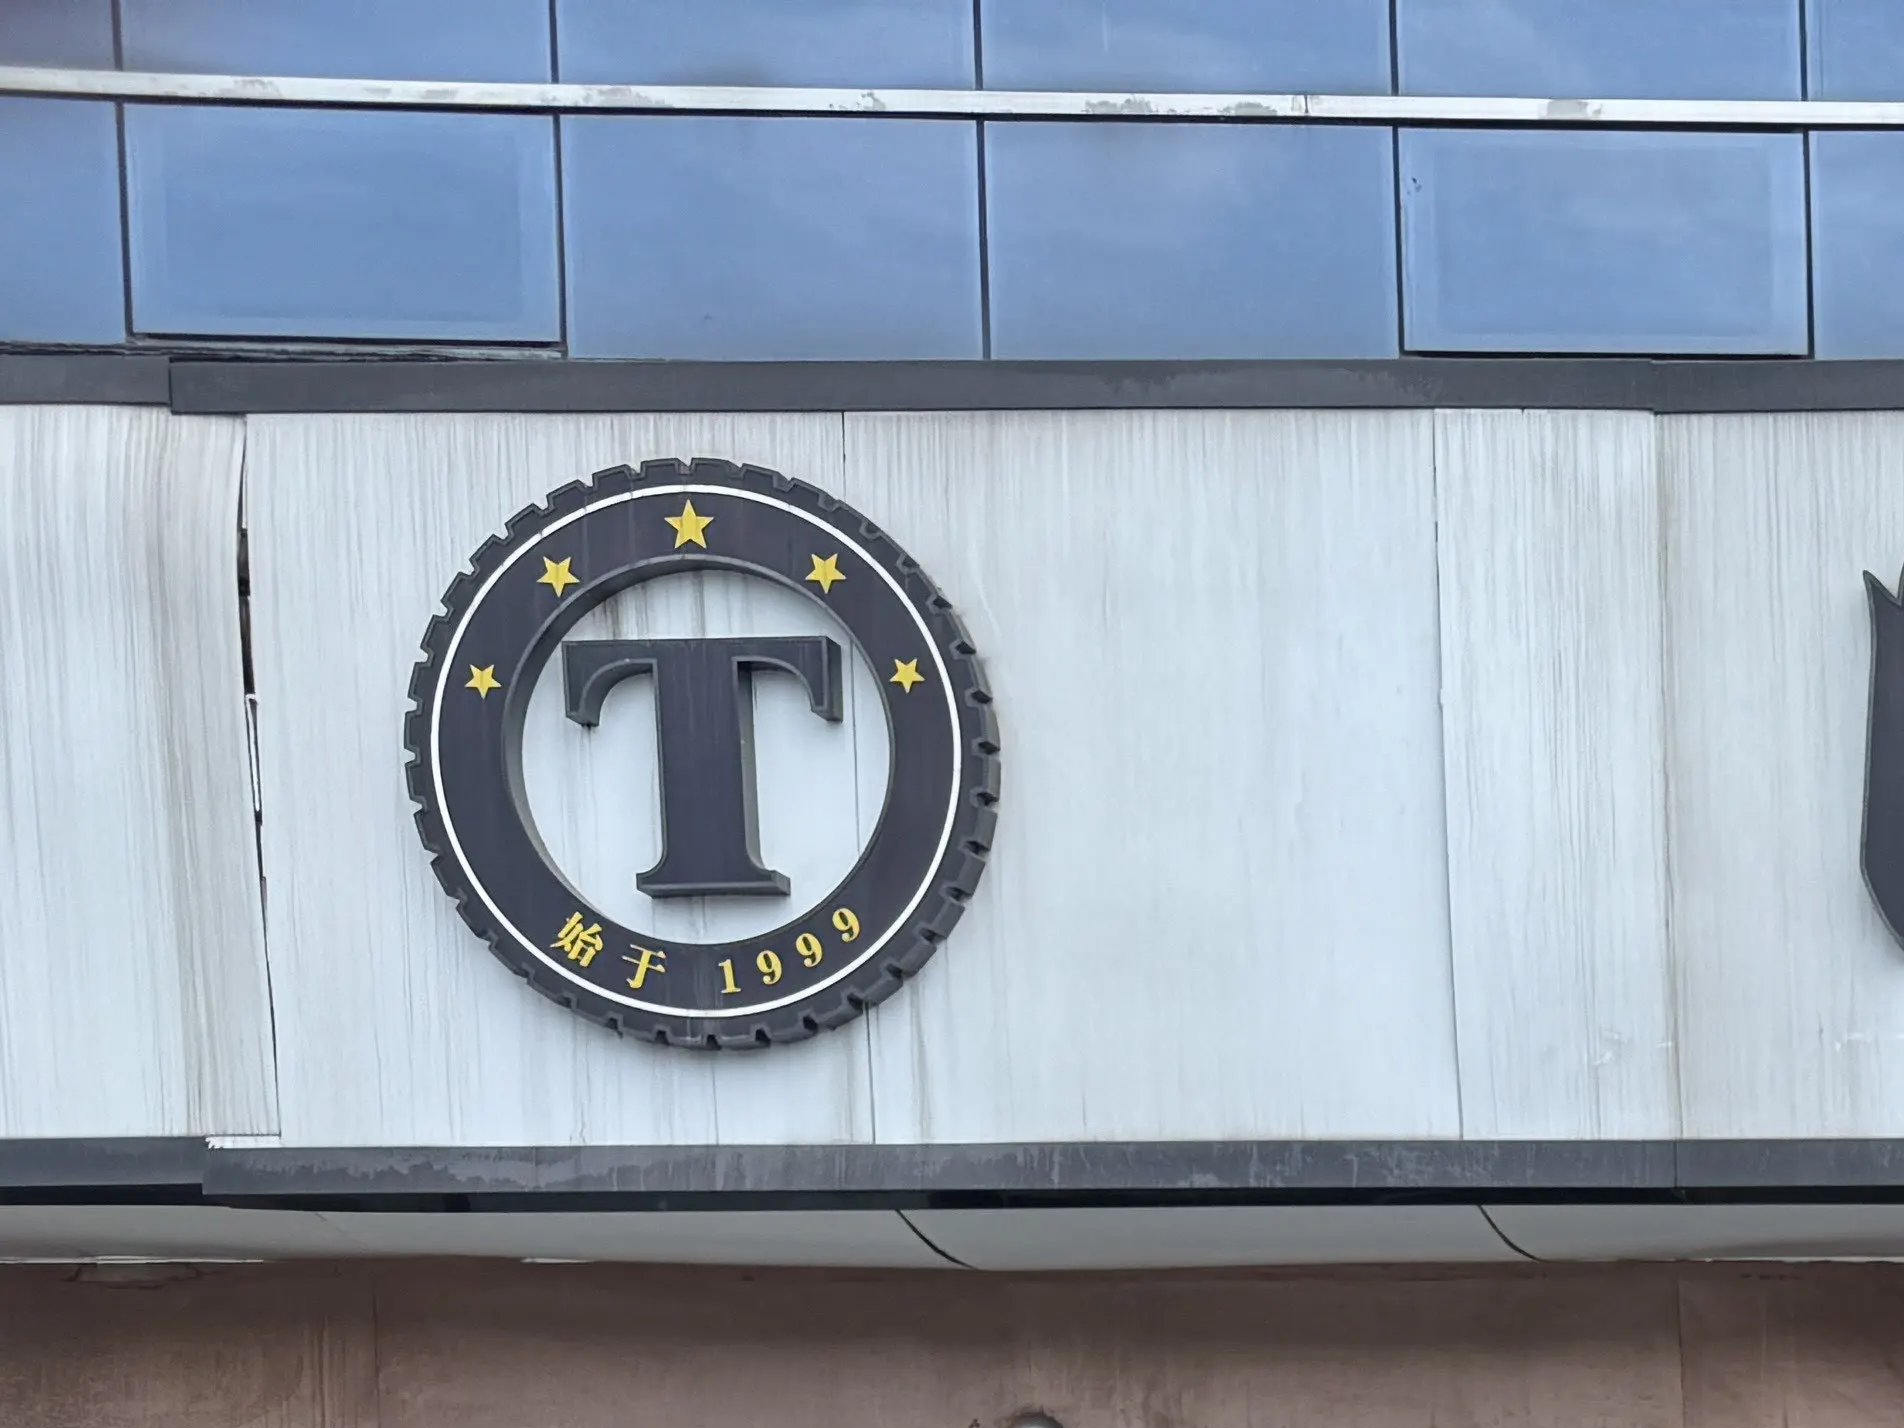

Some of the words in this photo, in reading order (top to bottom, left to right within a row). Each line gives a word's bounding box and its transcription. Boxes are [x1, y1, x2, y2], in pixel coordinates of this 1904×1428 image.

[561, 636, 844, 899] T
[550, 911, 667, 990] 始于
[717, 906, 861, 994] 1999
